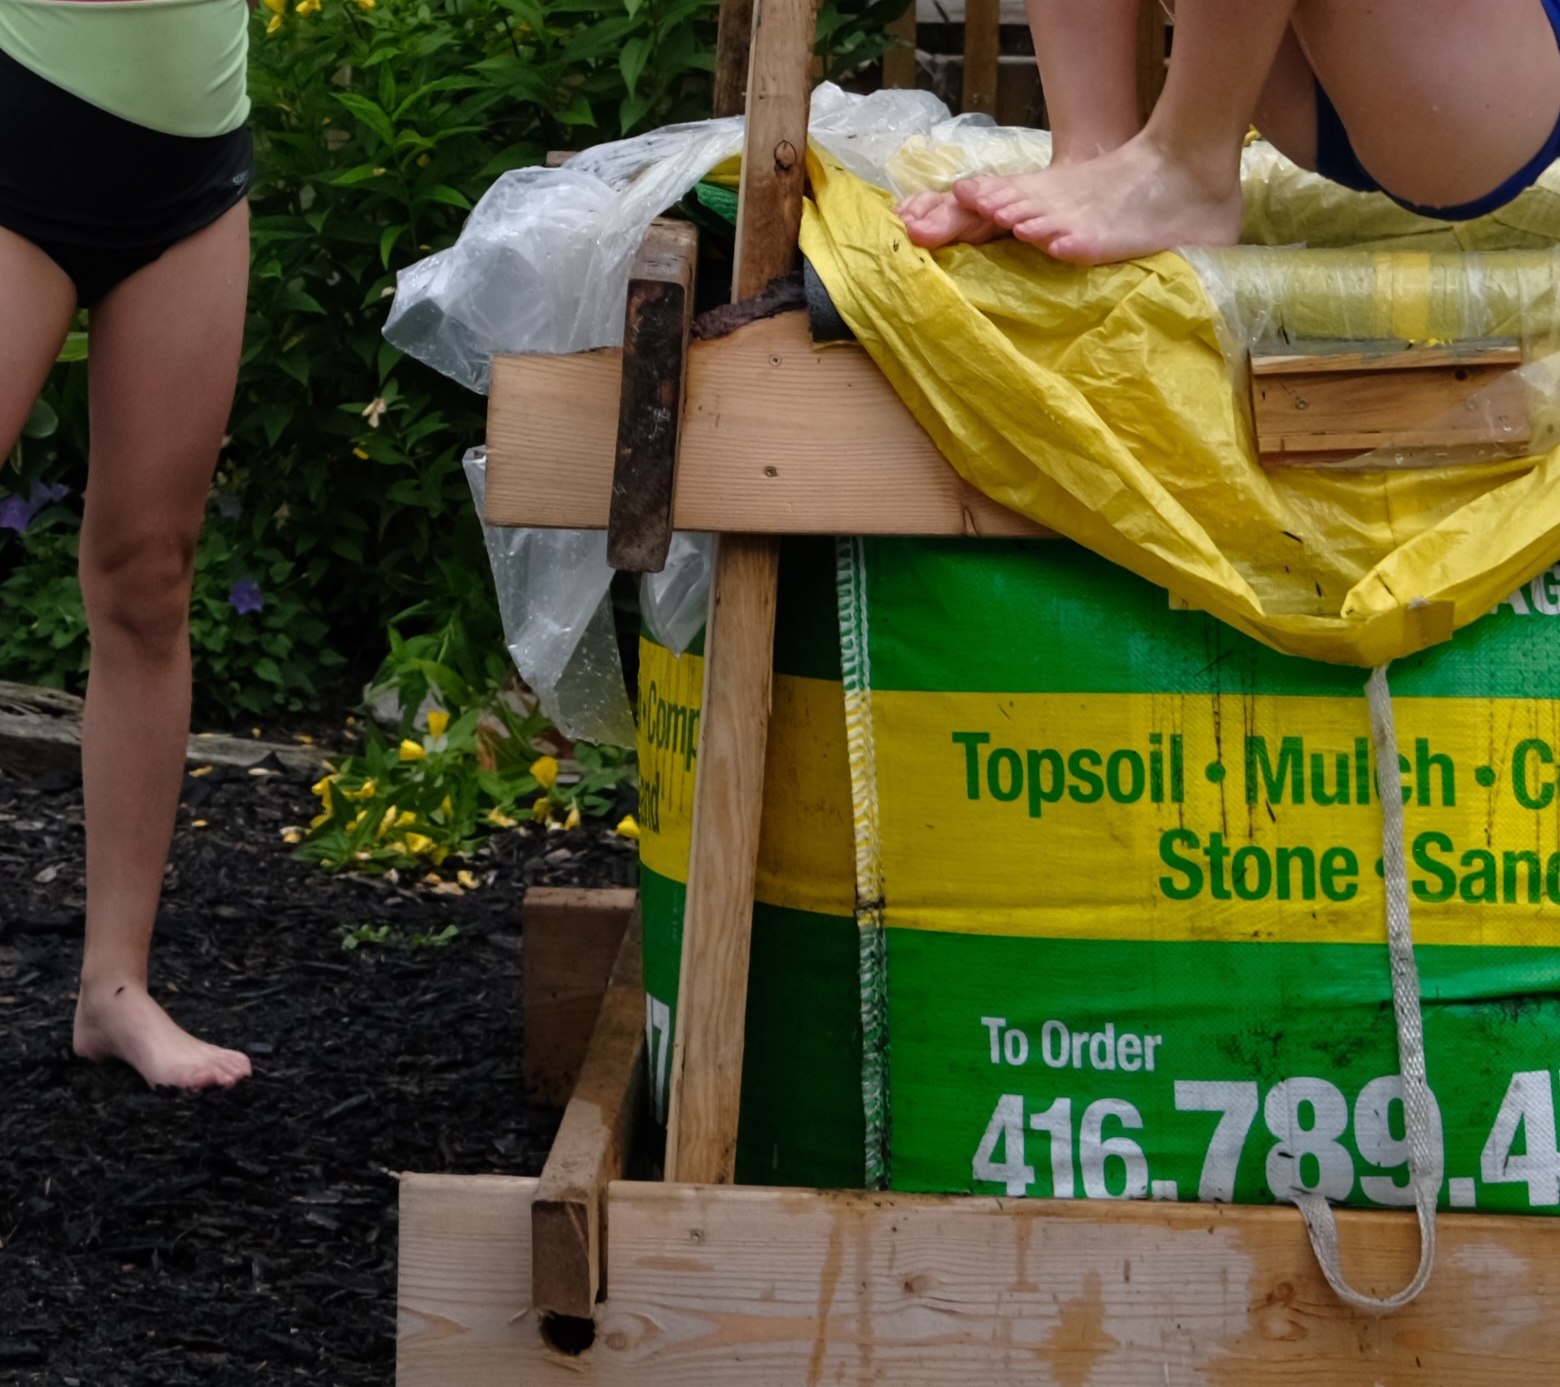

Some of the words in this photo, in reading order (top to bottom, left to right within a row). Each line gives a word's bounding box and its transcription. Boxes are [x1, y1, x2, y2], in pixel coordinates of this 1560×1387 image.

[952, 732, 1185, 818] Topsoil
[1158, 827, 1360, 902] Stone
[980, 1015, 1029, 1066] To
[1040, 1019, 1163, 1073] Order
